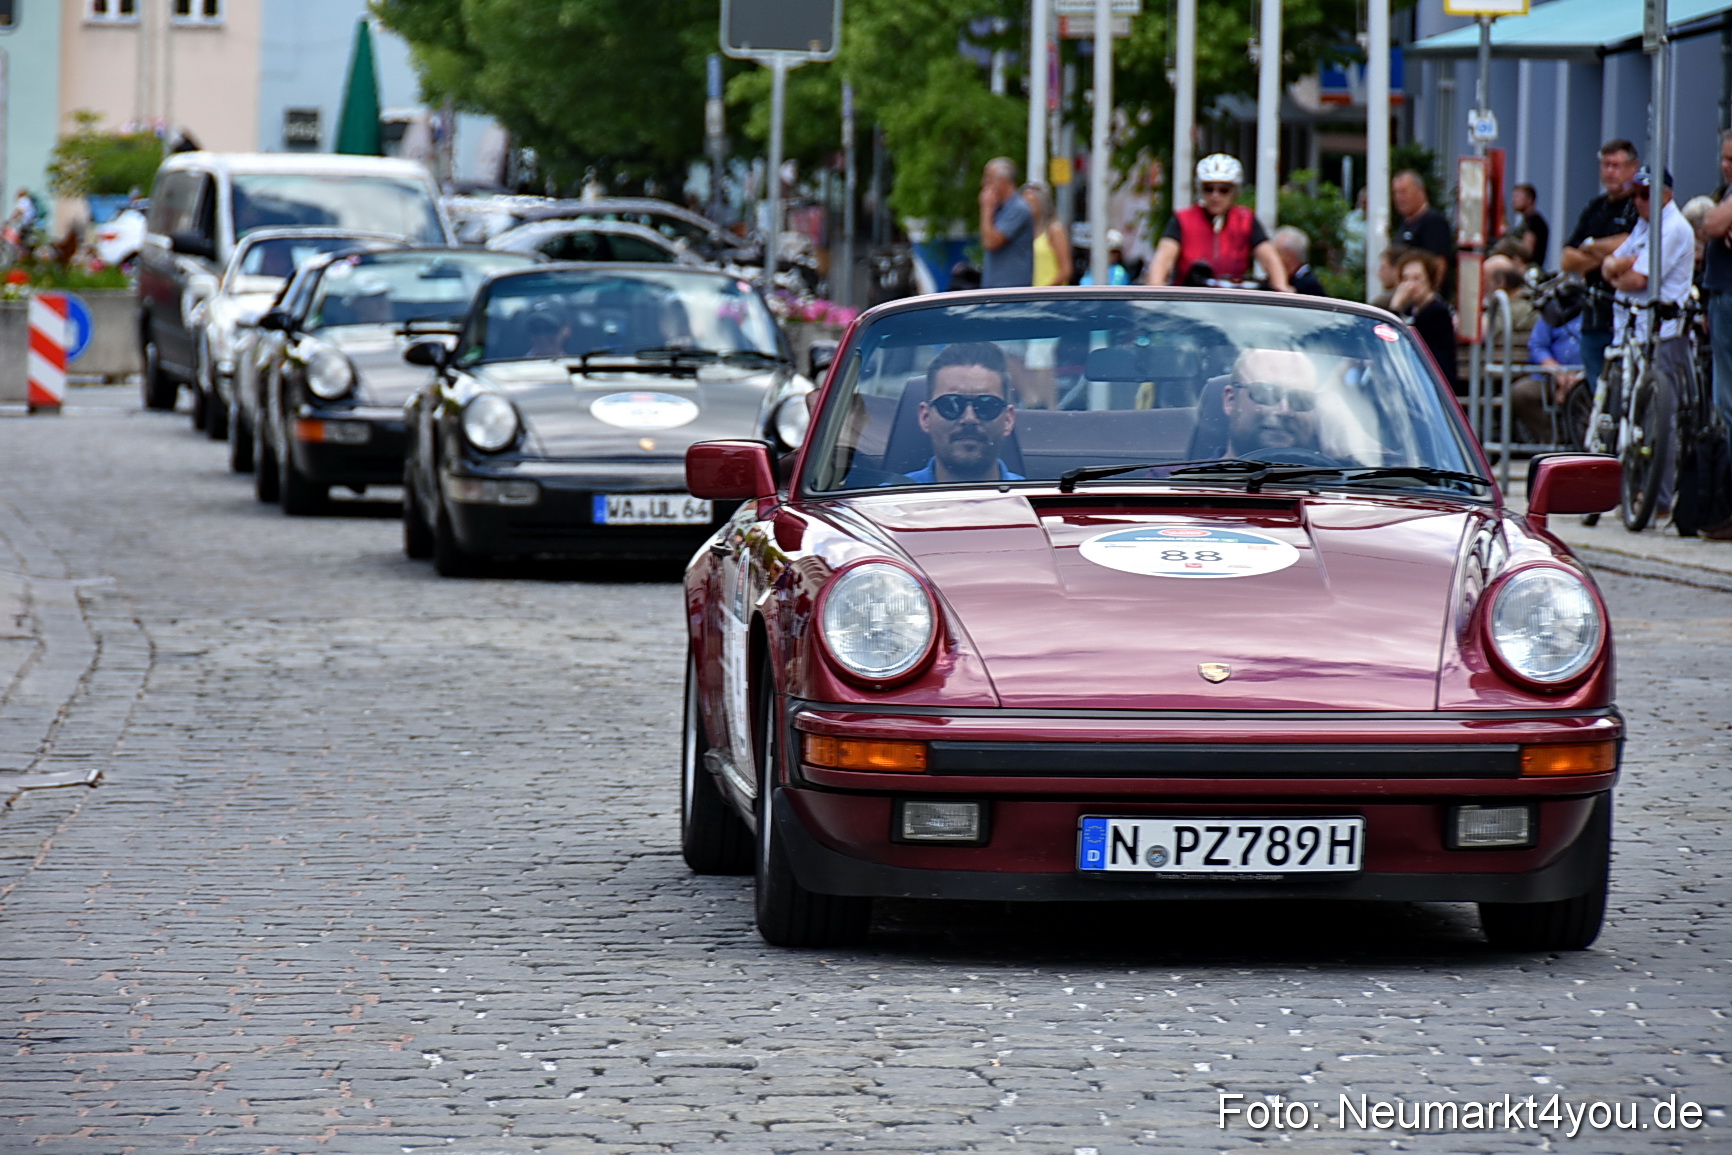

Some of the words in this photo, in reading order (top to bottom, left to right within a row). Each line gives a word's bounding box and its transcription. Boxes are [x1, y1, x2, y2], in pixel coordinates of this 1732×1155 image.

[1160, 549, 1224, 562] 88
[1087, 850, 1100, 862] D
[1110, 825, 1139, 865] N
